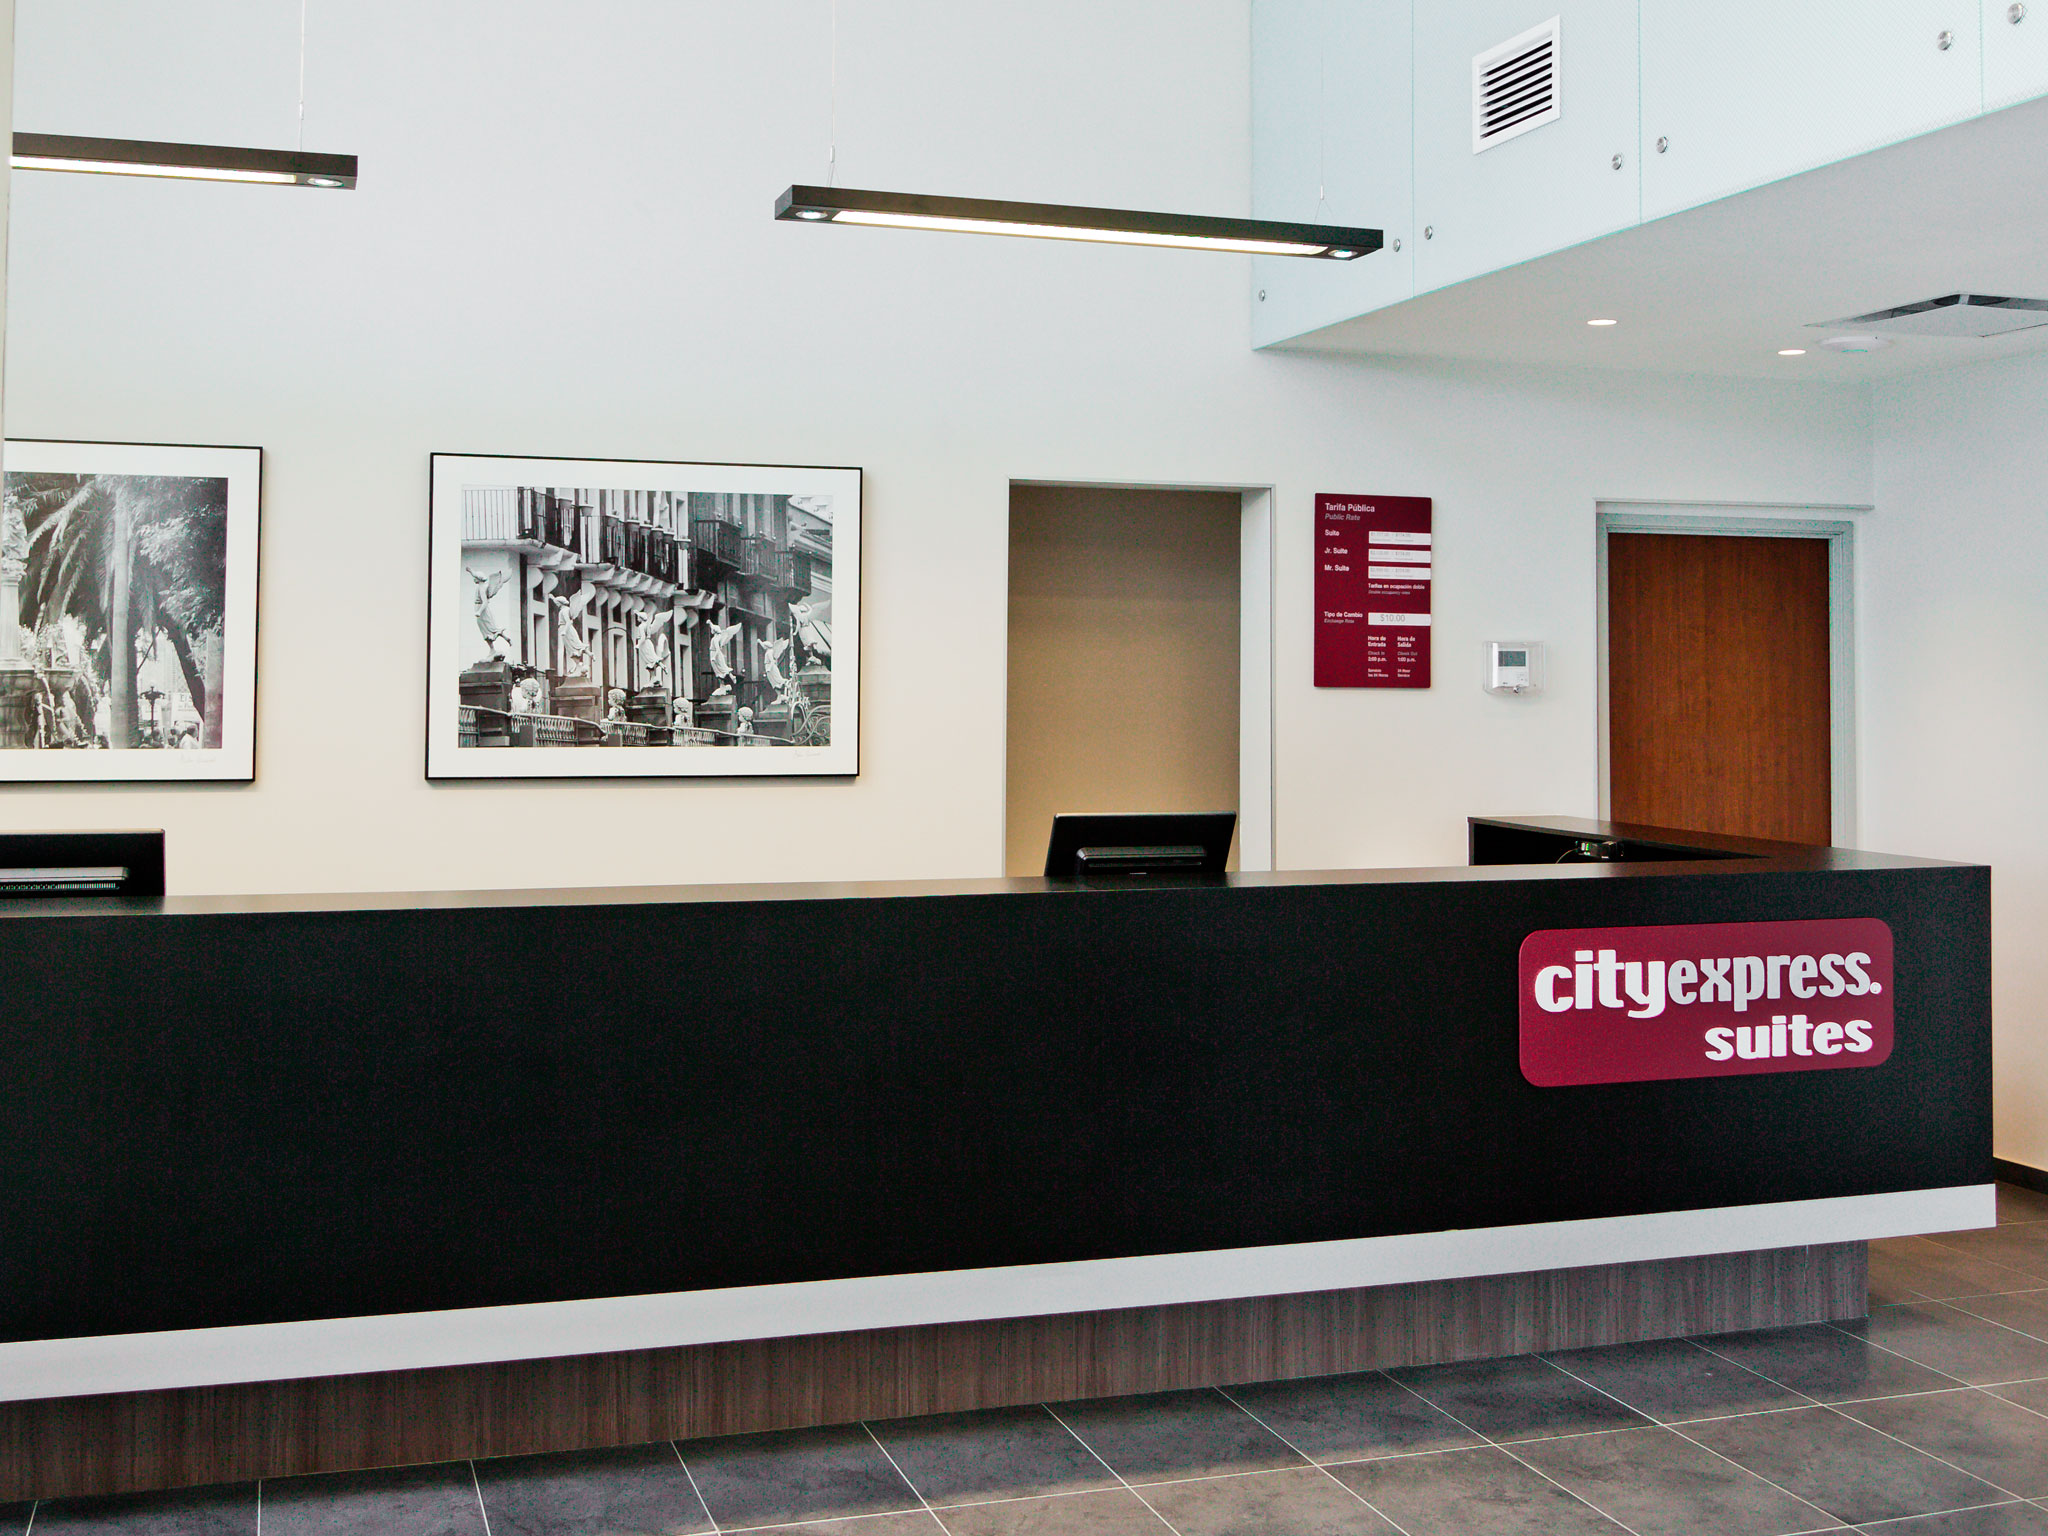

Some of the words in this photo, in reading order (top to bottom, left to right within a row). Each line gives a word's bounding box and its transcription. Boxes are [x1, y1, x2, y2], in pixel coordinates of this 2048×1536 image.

[1325, 503, 1346, 511] Tarifa
[1348, 503, 1375, 512] Pública
[1380, 614, 1406, 622] $10.00
[1704, 1014, 1874, 1061] suites
